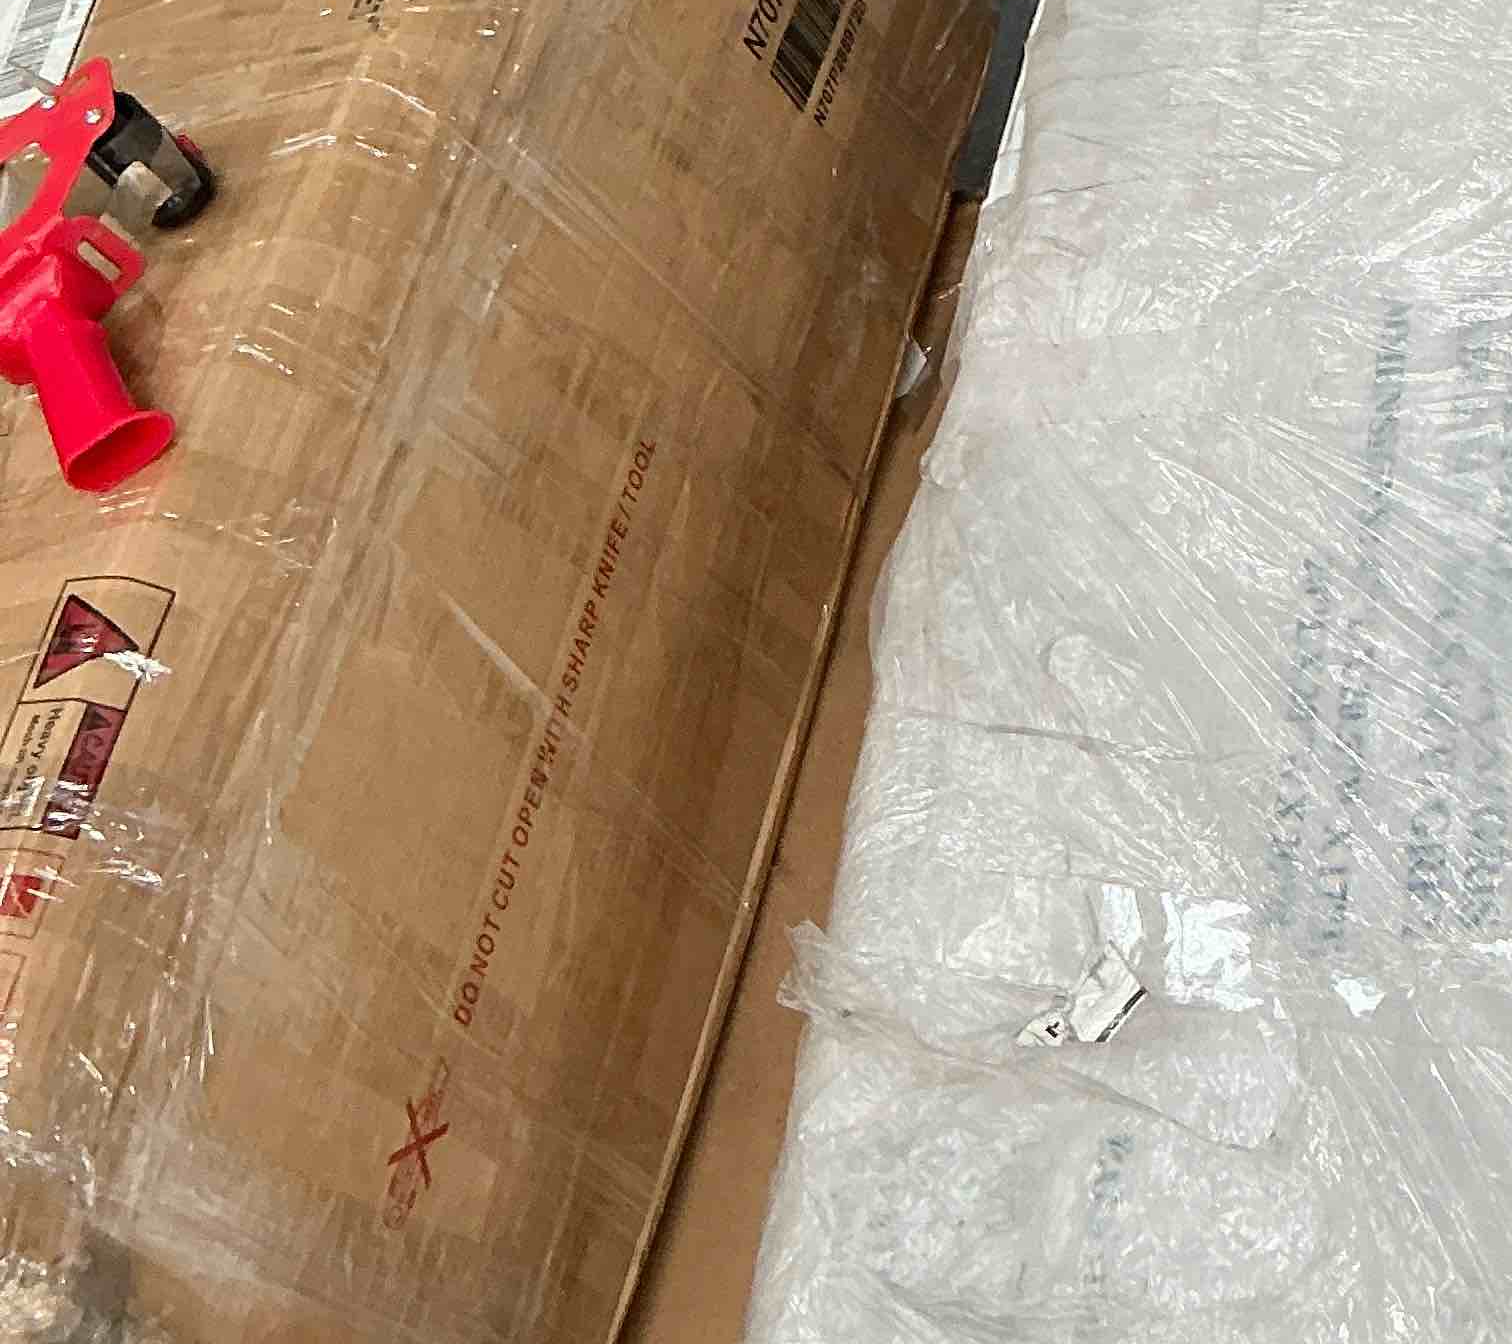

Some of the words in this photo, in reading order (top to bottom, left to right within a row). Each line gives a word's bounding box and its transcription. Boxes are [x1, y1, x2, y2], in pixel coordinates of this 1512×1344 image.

[454, 981, 480, 1027] DO
[470, 912, 500, 977] NOT
[492, 849, 520, 911] CUT
[512, 767, 549, 847] OPEN
[537, 695, 573, 764] WITH
[563, 599, 599, 692] SHARP
[592, 518, 629, 599] KNIFE
